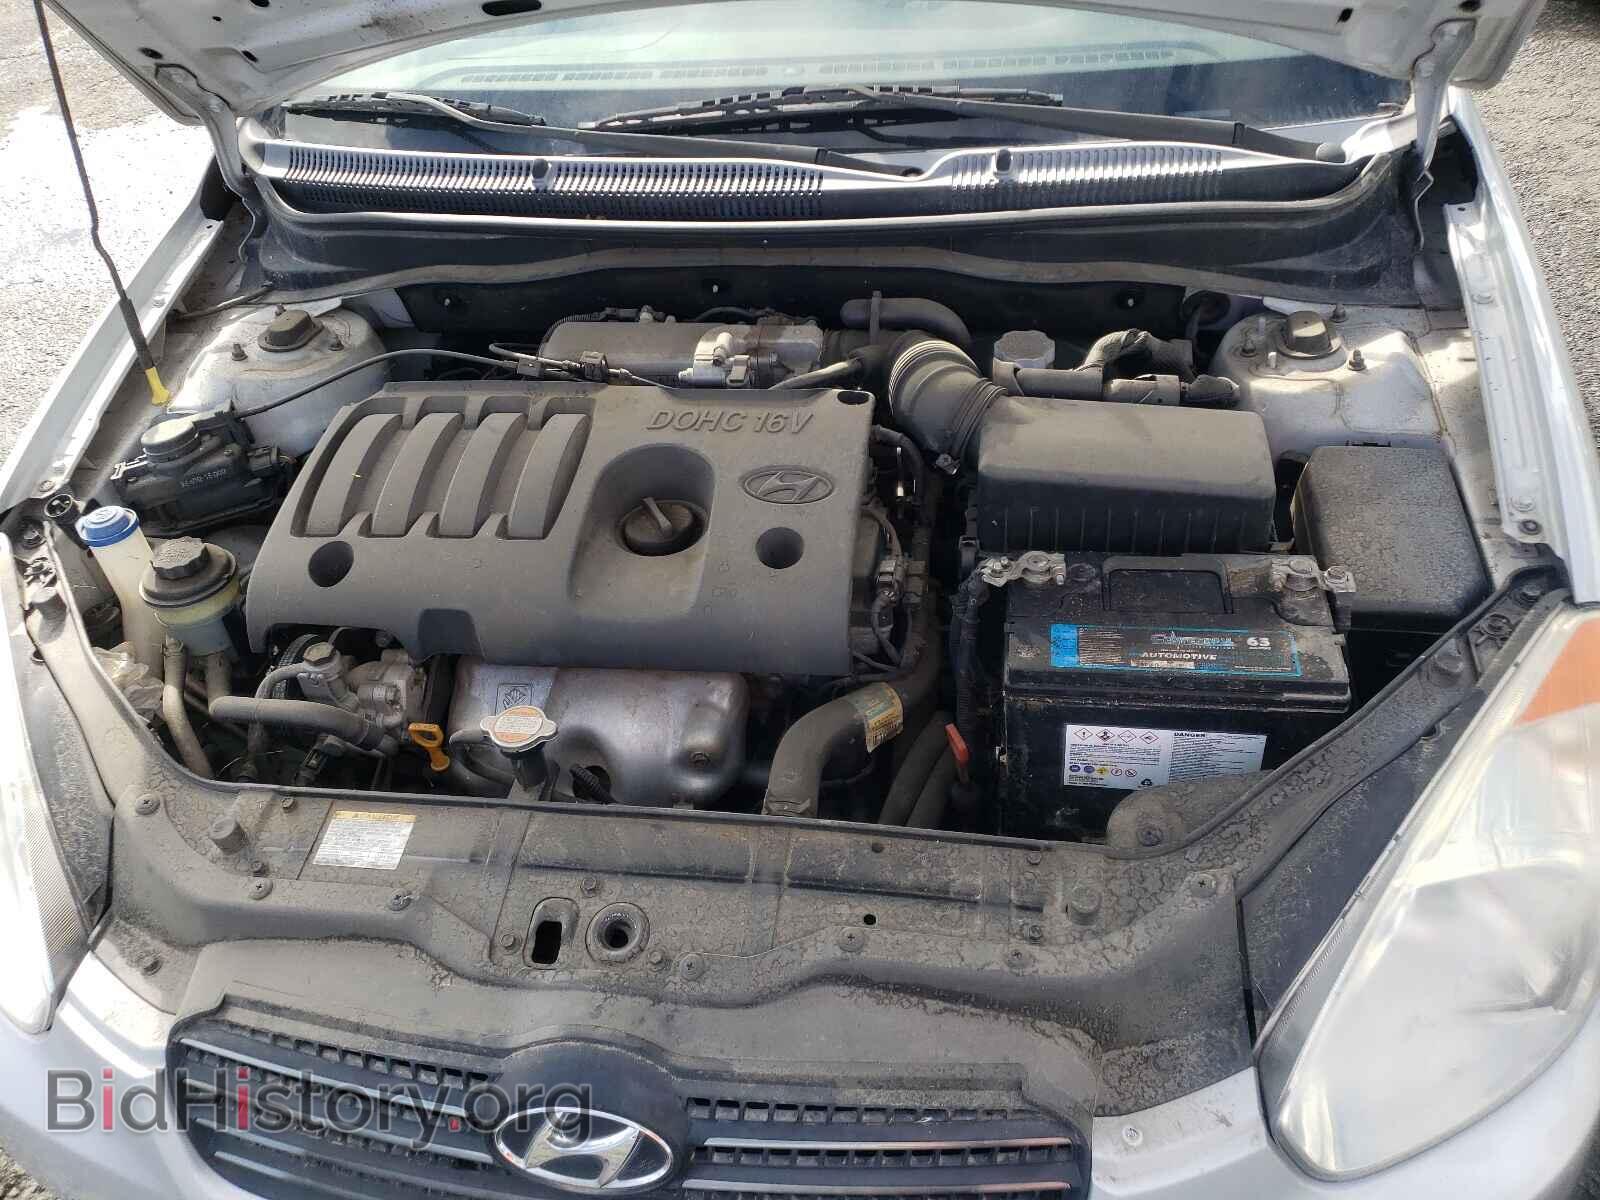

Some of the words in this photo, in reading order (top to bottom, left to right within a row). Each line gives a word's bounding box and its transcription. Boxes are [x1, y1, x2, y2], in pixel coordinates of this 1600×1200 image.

[646, 408, 748, 433] DOHC
[754, 408, 814, 435] 16V
[1141, 651, 1218, 661] AUTOMOTIVE
